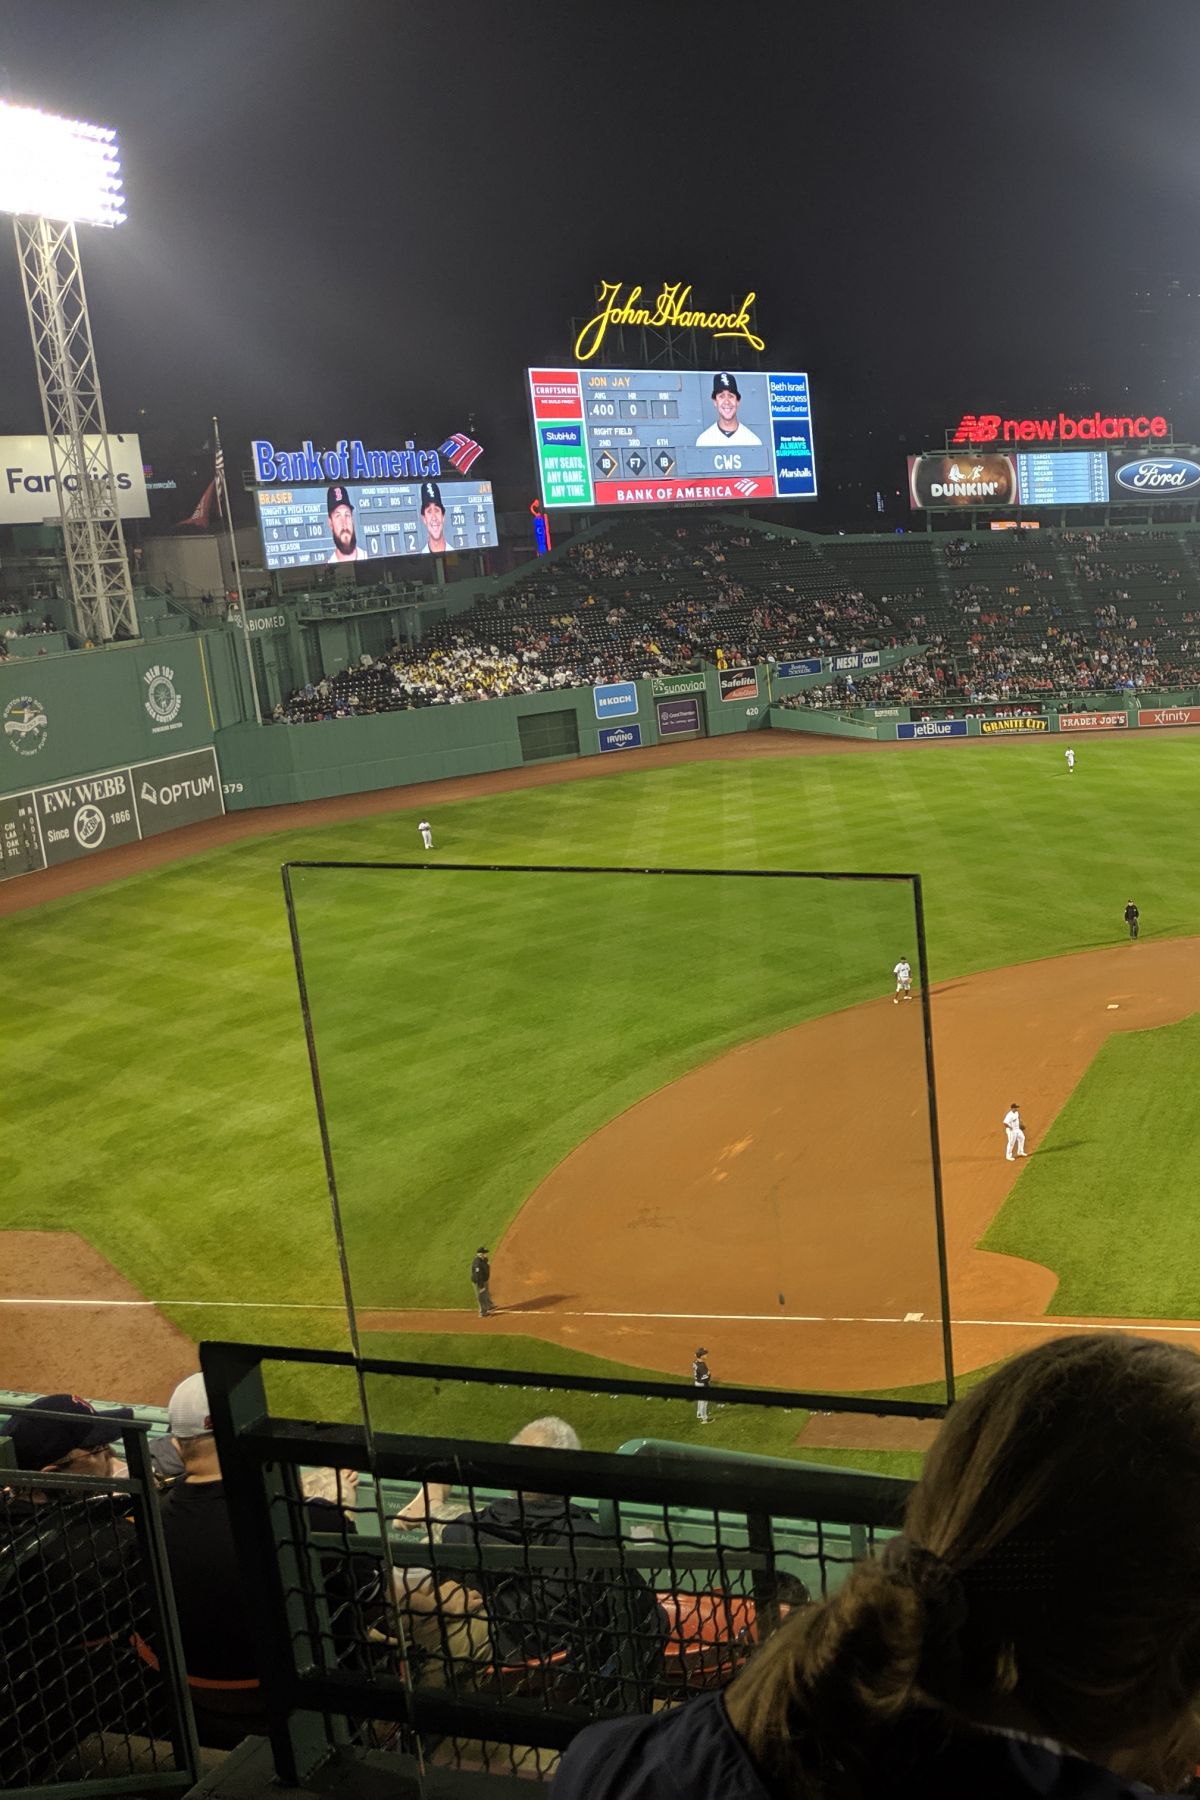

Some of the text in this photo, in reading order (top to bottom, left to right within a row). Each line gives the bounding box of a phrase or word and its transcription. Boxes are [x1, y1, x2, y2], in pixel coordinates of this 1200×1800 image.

[575, 280, 765, 361] John Hancock
[588, 377, 631, 387] JON JAY
[770, 381, 805, 392] Beth Israel
[535, 386, 577, 395] CRAFTSMAN
[770, 393, 807, 402] Deaconess
[589, 404, 614, 416] .400
[629, 404, 637, 416] 0
[771, 404, 808, 412] Medical Center
[546, 431, 577, 441] StubHub
[593, 427, 633, 436] RIGHT FIELD
[599, 439, 611, 447] 2ND
[780, 442, 807, 450] ALWAYS
[252, 440, 441, 482] Bank of America
[544, 457, 585, 470] ANY SEATS,
[602, 457, 669, 469] 1B F7 1B
[714, 454, 742, 470] CWS
[546, 470, 586, 483] ANY GAME,
[779, 467, 812, 478] Marshalls
[1133, 463, 1186, 488] Ford
[551, 484, 585, 498] ANY TIME
[616, 486, 732, 501] BANK OF AMERICA
[930, 482, 998, 497] DUNKIN'
[259, 492, 294, 505] BRASIER
[304, 505, 320, 513] COUNT
[265, 518, 282, 526] TOTAL
[453, 516, 465, 525] .270
[272, 526, 323, 540] 6 6 100
[363, 522, 417, 534] BALLS STRIKES OUTS
[279, 543, 301, 552] SEASON
[371, 537, 379, 554] 0
[408, 534, 416, 551] 2
[268, 557, 279, 566] ERA
[836, 657, 859, 669] NESN
[664, 681, 705, 694] sunovion
[721, 678, 755, 688] Safelite
[607, 694, 632, 705] KOCH
[746, 707, 759, 716] 420
[1154, 711, 1190, 724] xfinity
[982, 718, 1047, 733] GRANITE CITY
[1062, 715, 1125, 727] TRADER JOE'S
[912, 724, 951, 738] jetBlue
[606, 732, 634, 744] IRVING
[78, 775, 126, 803] WEBB
[159, 775, 215, 806] OPTUM
[223, 783, 244, 794] 379
[4, 822, 16, 831] CIN
[48, 809, 131, 843] Since 1866
[5, 830, 17, 840] LAA
[6, 840, 20, 848] OAK
[8, 848, 20, 857] STL
